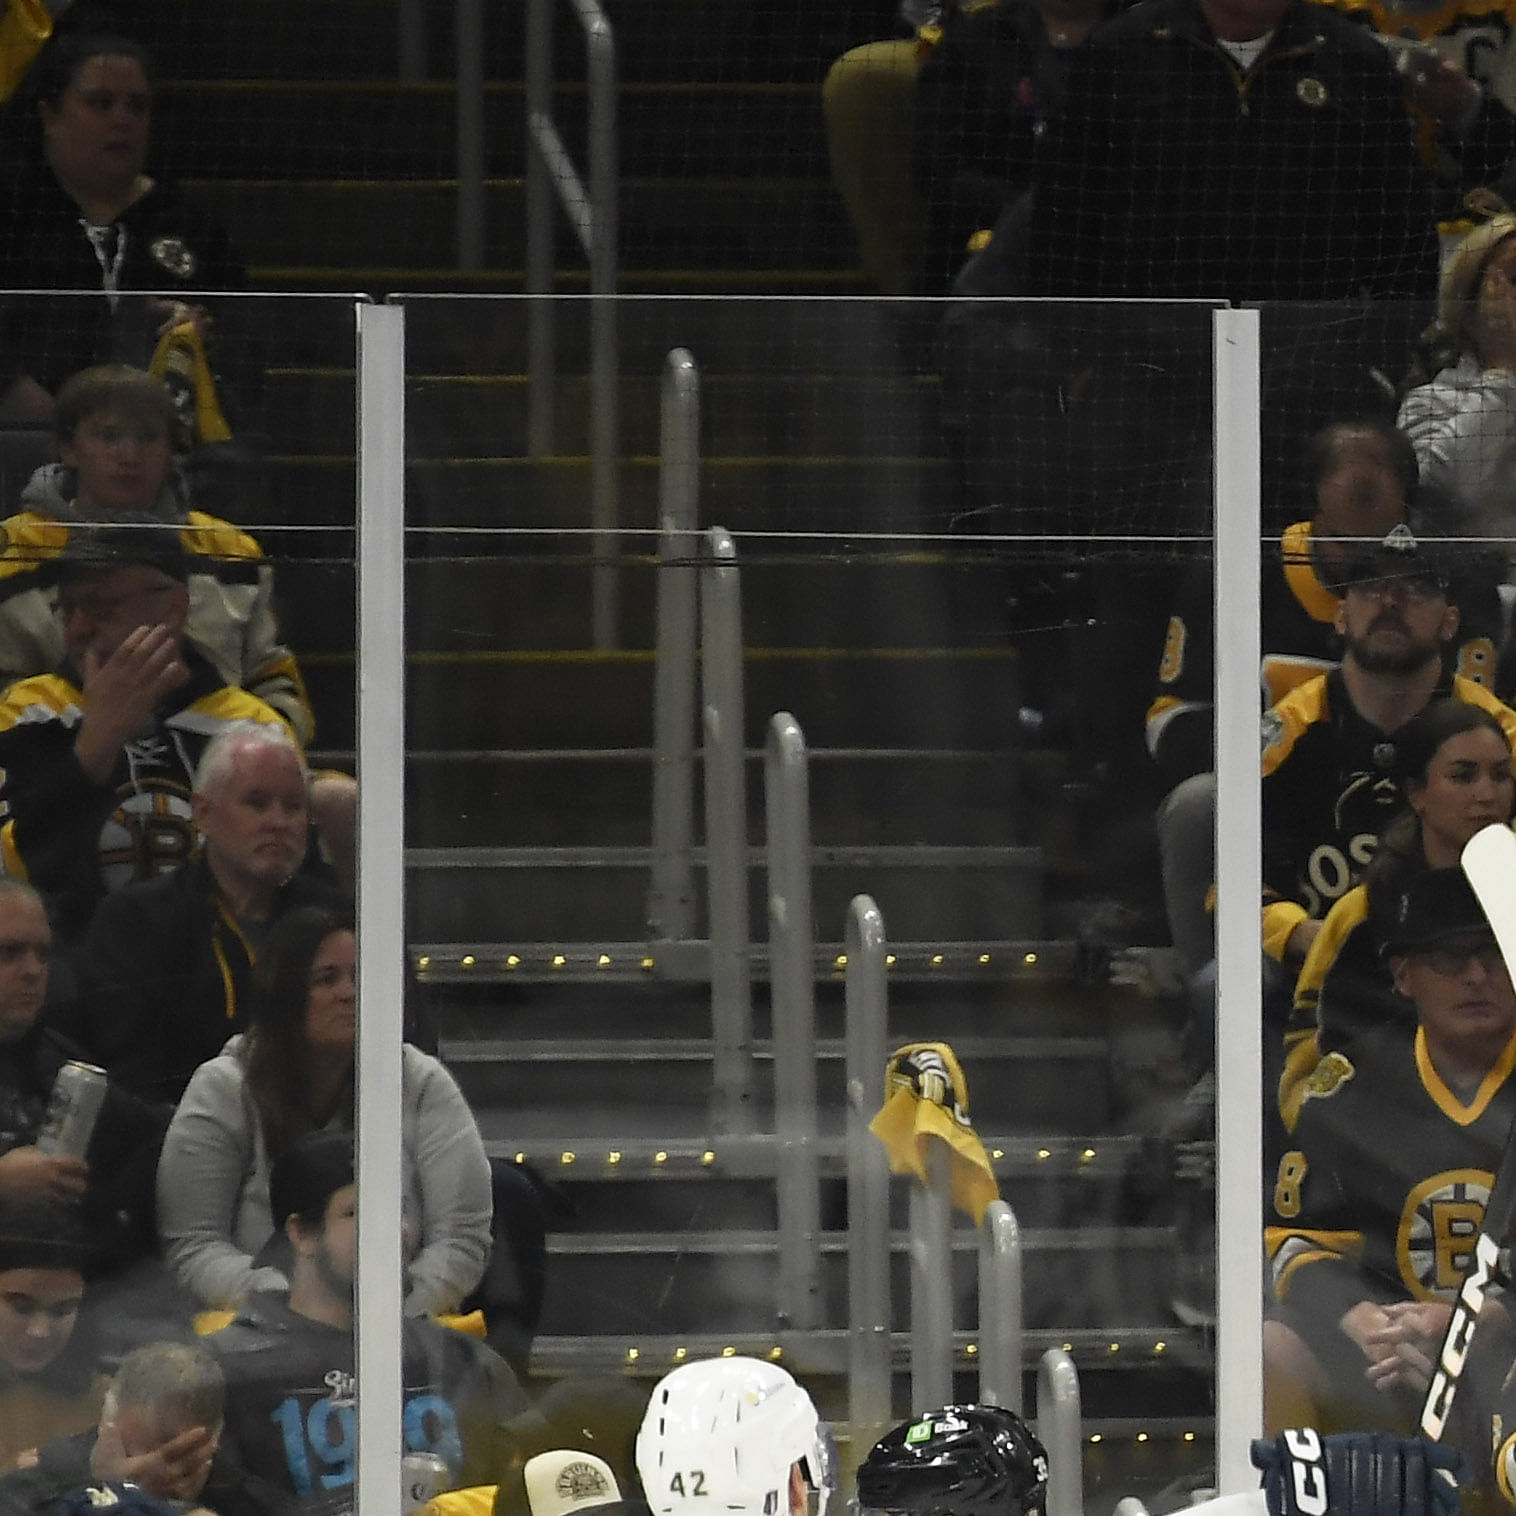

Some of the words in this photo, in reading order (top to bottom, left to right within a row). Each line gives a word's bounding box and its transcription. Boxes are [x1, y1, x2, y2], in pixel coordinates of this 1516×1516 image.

[1272, 1150, 1308, 1219] 8
[1408, 1233, 1499, 1441] CCM
[272, 1392, 462, 1496] 199
[669, 1470, 717, 1498] 42
[1284, 1427, 1330, 1516] CC
